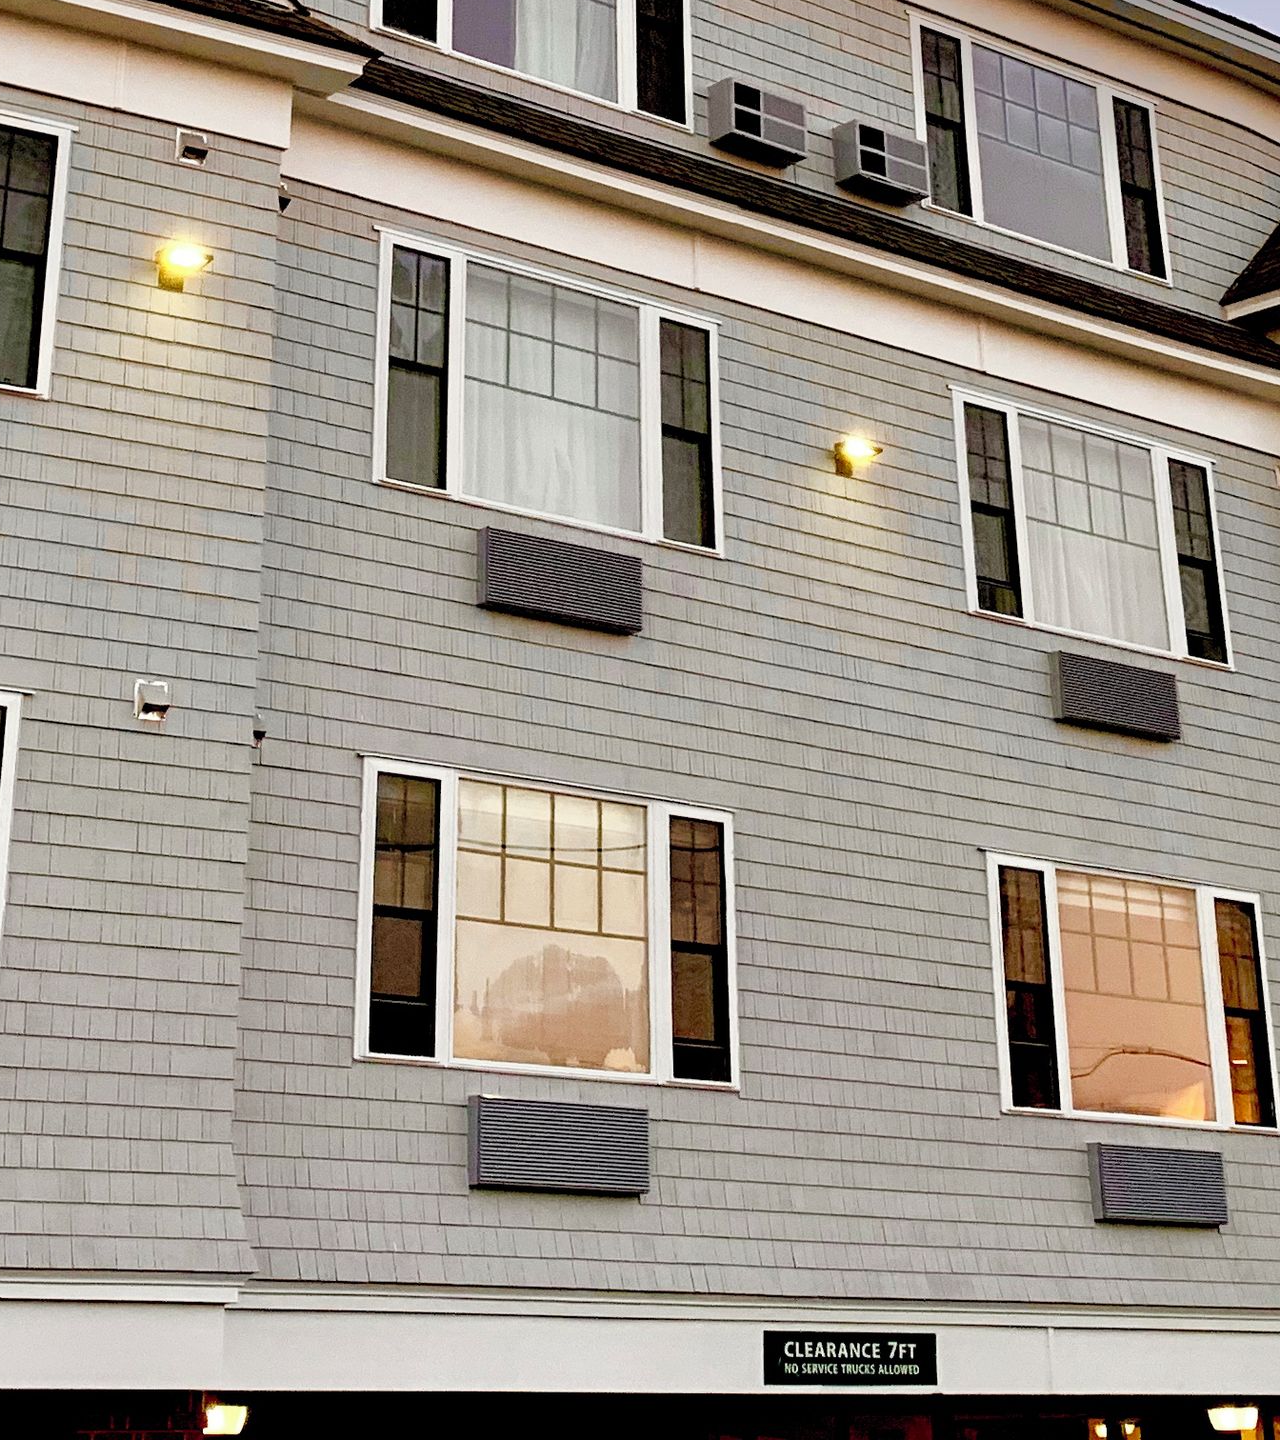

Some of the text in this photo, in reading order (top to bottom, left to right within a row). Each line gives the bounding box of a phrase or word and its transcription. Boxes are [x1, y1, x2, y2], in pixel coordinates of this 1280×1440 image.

[784, 1341, 917, 1359] CLEARANCE 7FT
[784, 1363, 920, 1375] NO SERVICE TRUCKS ALLOWED
